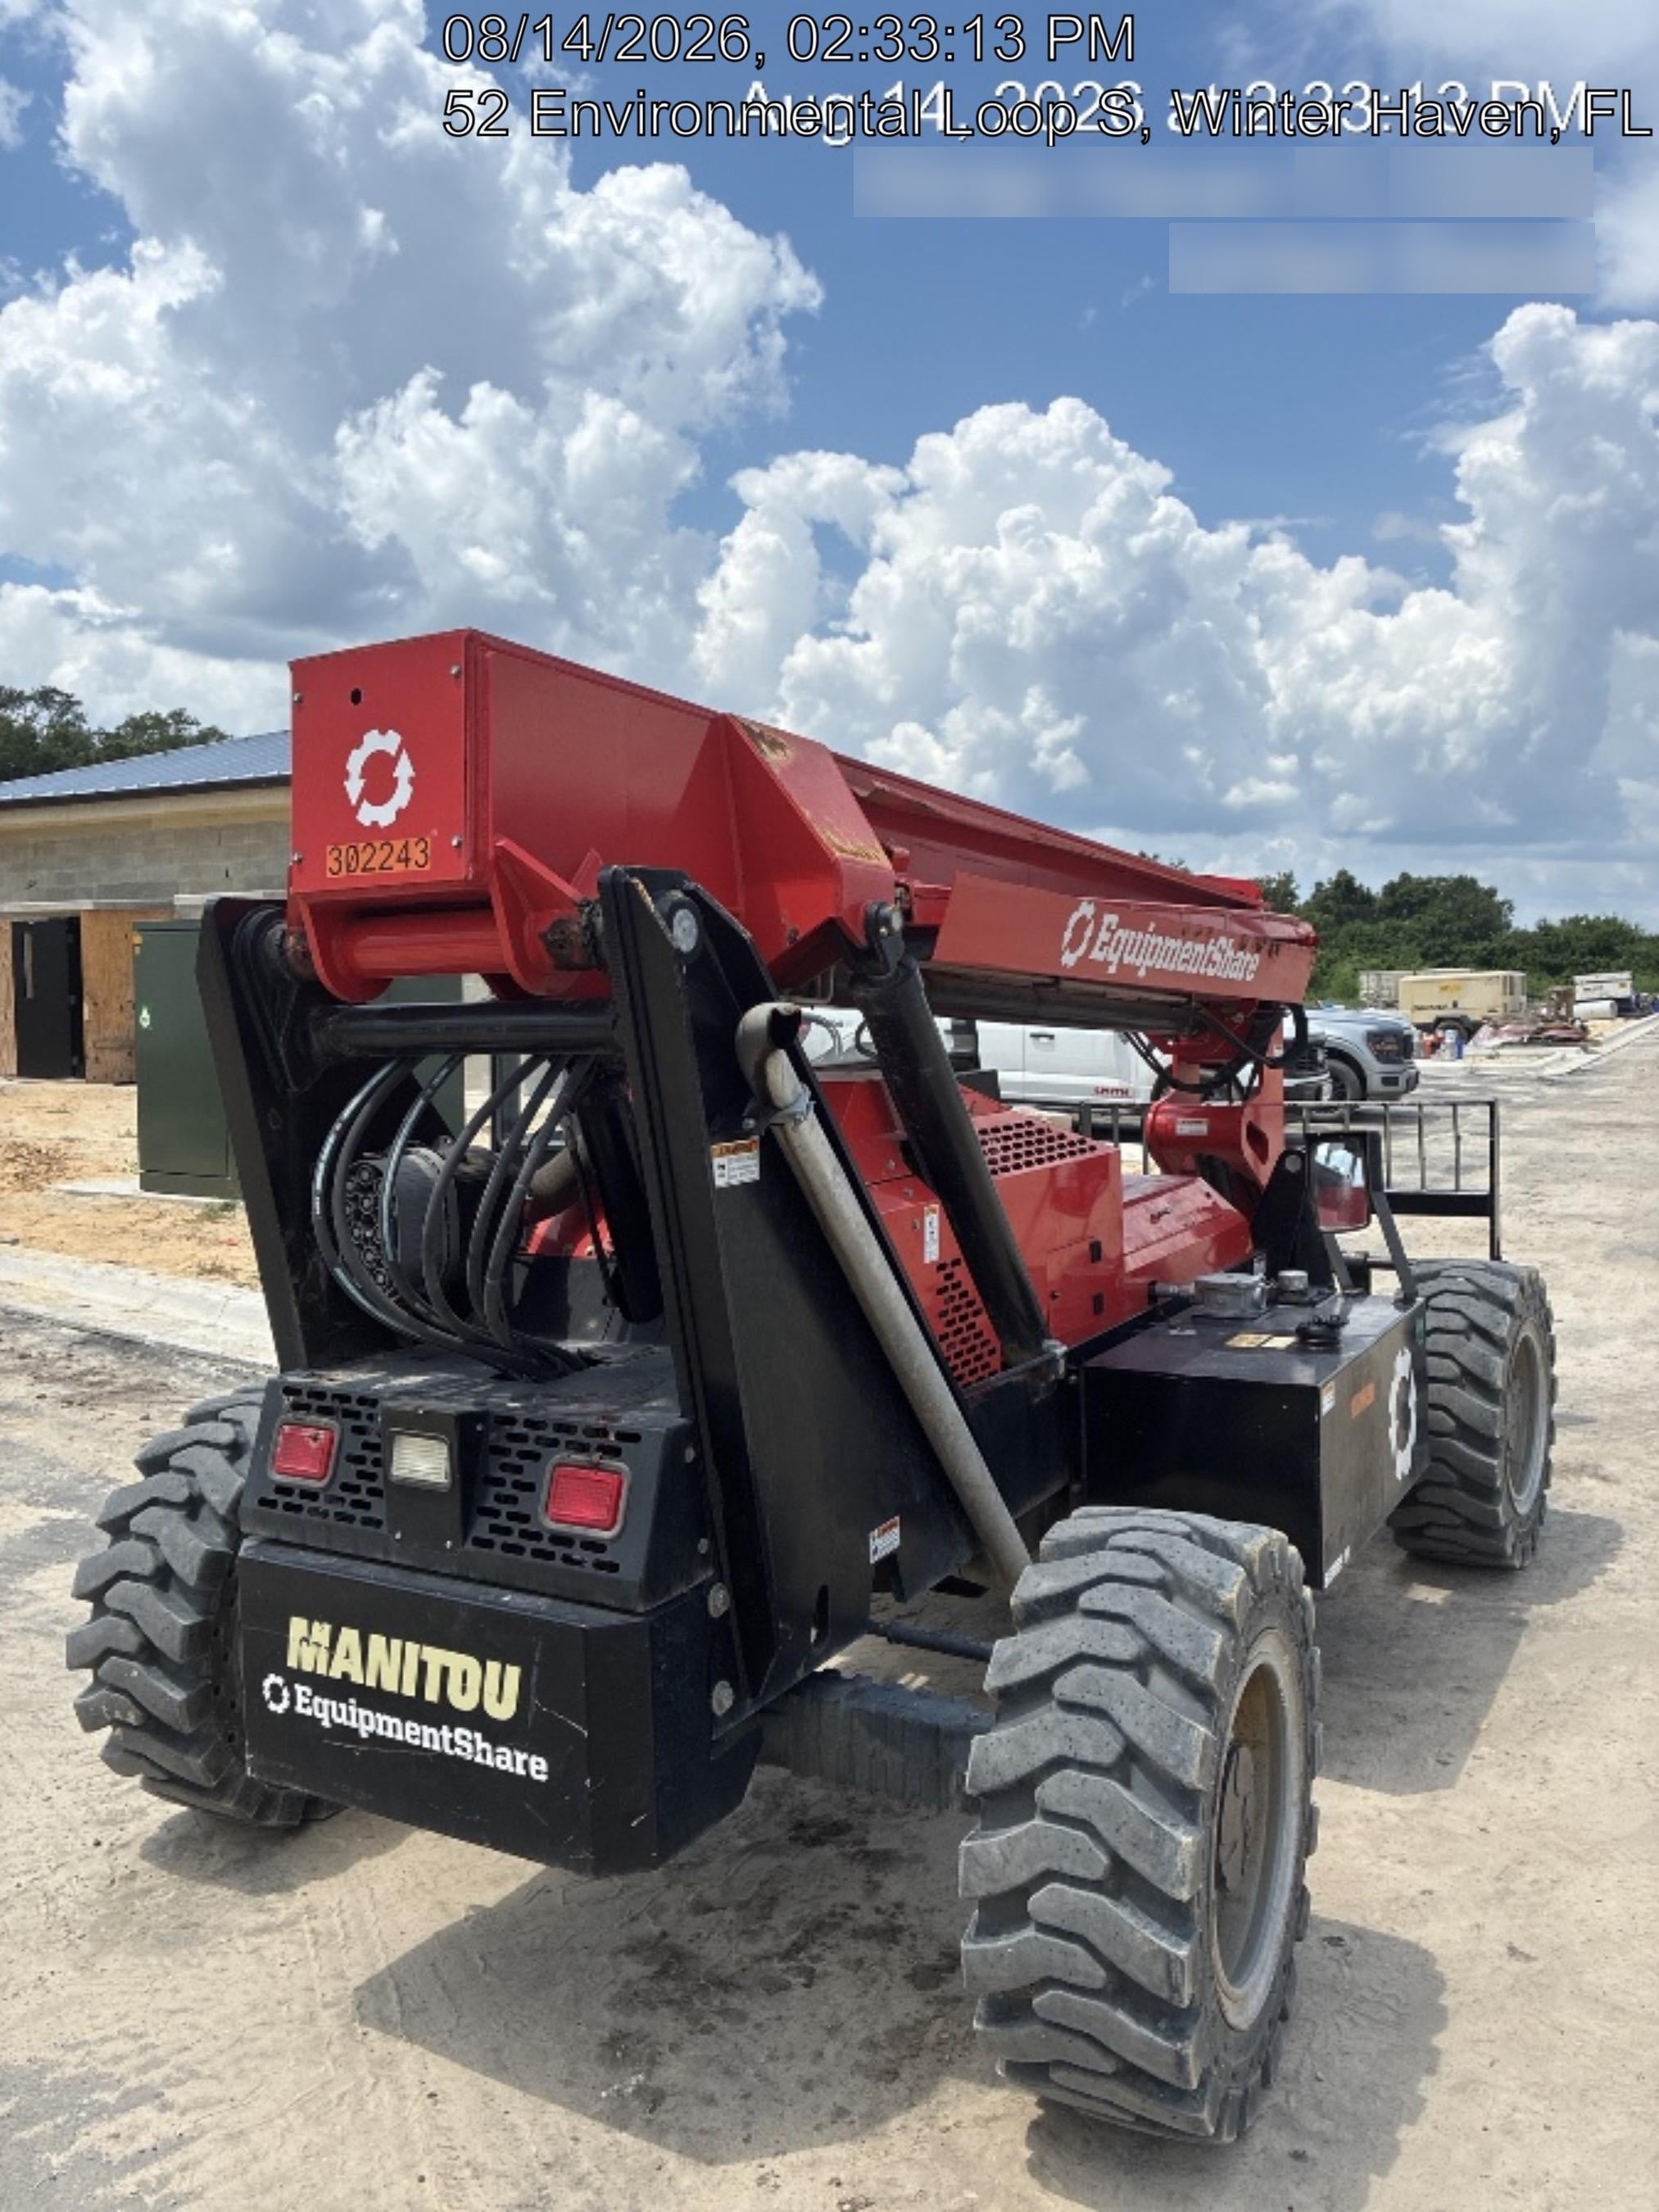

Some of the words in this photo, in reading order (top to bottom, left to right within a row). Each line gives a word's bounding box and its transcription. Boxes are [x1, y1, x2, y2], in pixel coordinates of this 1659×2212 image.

[329, 837, 429, 877] 302243
[1091, 913, 1260, 981] EquipmentShare
[287, 1616, 521, 1721] MANITOU
[294, 1684, 549, 1783] EquipmentShare
